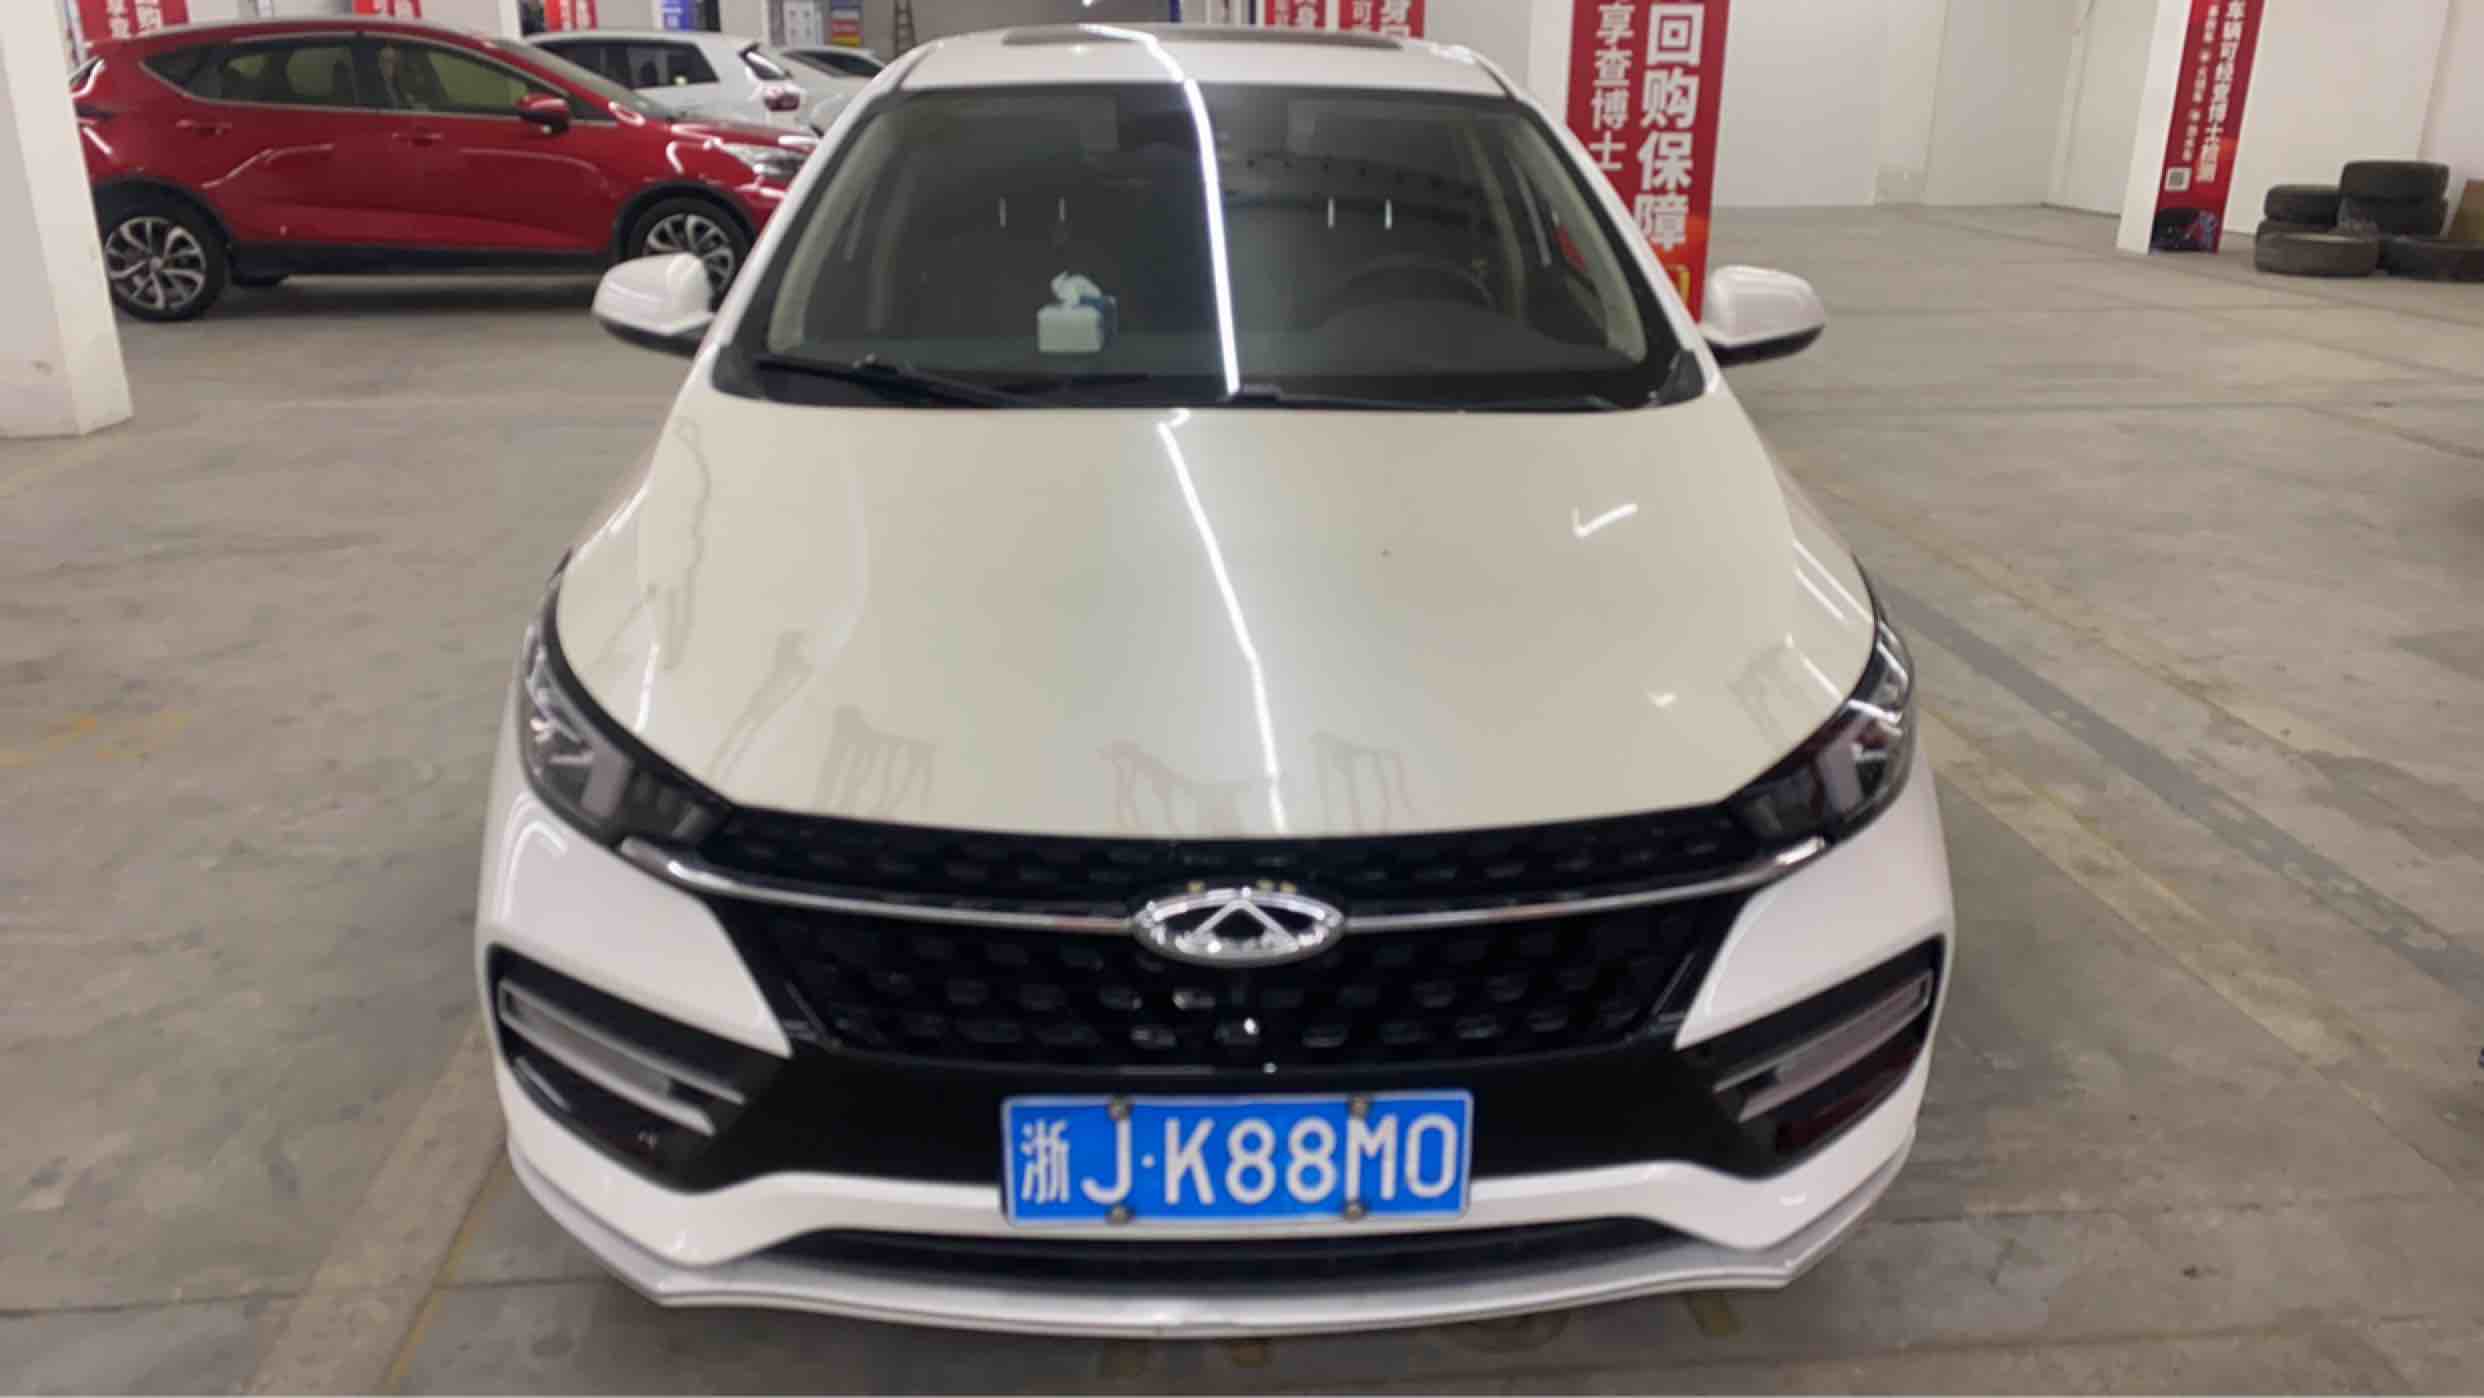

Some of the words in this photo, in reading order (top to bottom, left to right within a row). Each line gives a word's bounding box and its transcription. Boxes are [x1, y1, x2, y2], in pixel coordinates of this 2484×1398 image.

[1588, 2, 1637, 172] 享查博士
[1631, 3, 1706, 252] 回购保障
